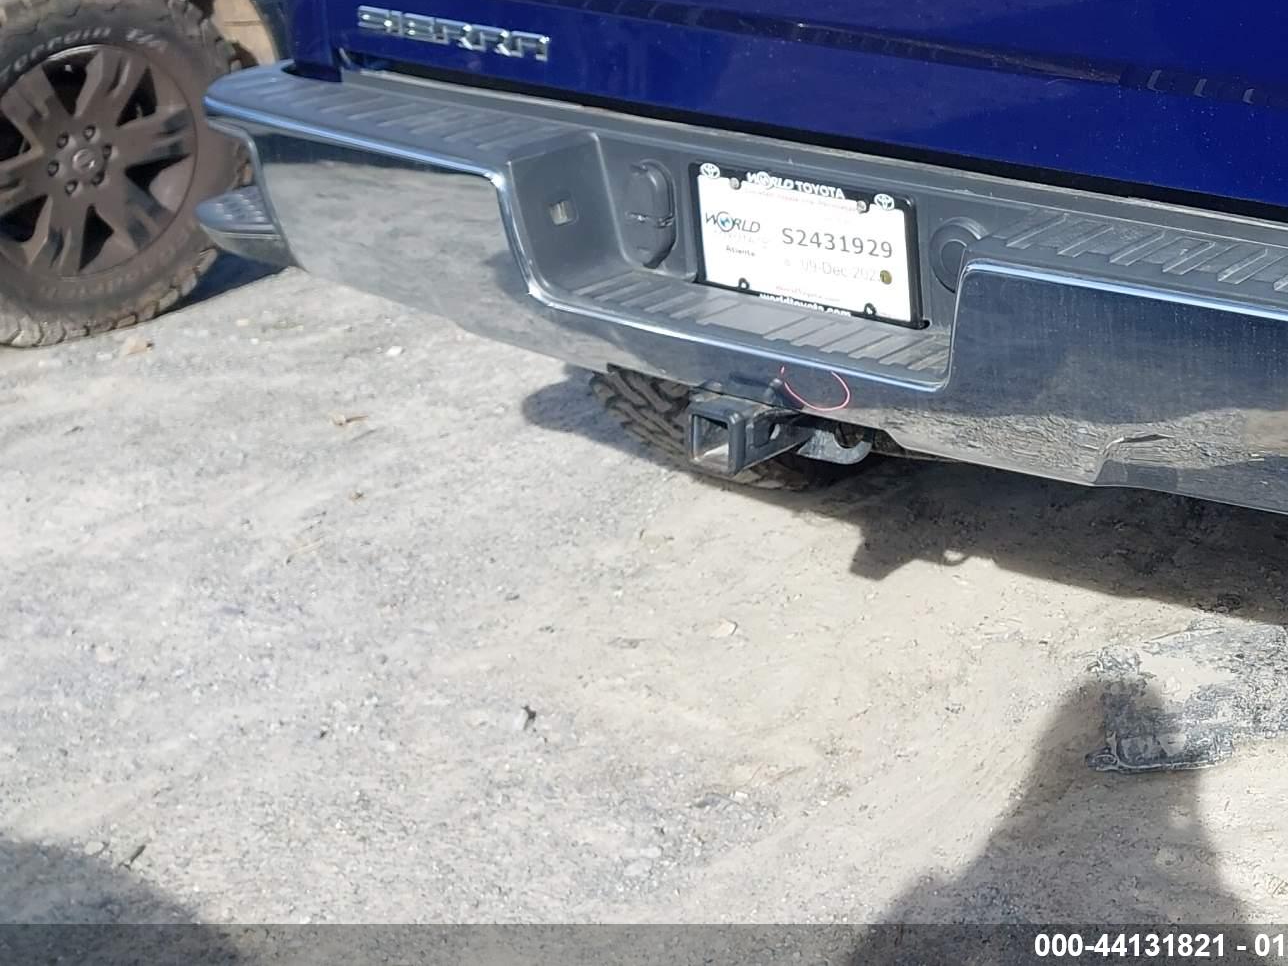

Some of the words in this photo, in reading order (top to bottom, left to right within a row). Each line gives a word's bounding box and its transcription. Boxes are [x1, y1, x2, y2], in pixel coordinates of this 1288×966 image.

[357, 4, 551, 62] SIERRA
[745, 171, 794, 191] WORLD
[795, 180, 846, 200] TOYOTA
[704, 210, 761, 233] WORLD
[781, 227, 894, 259] S2431929
